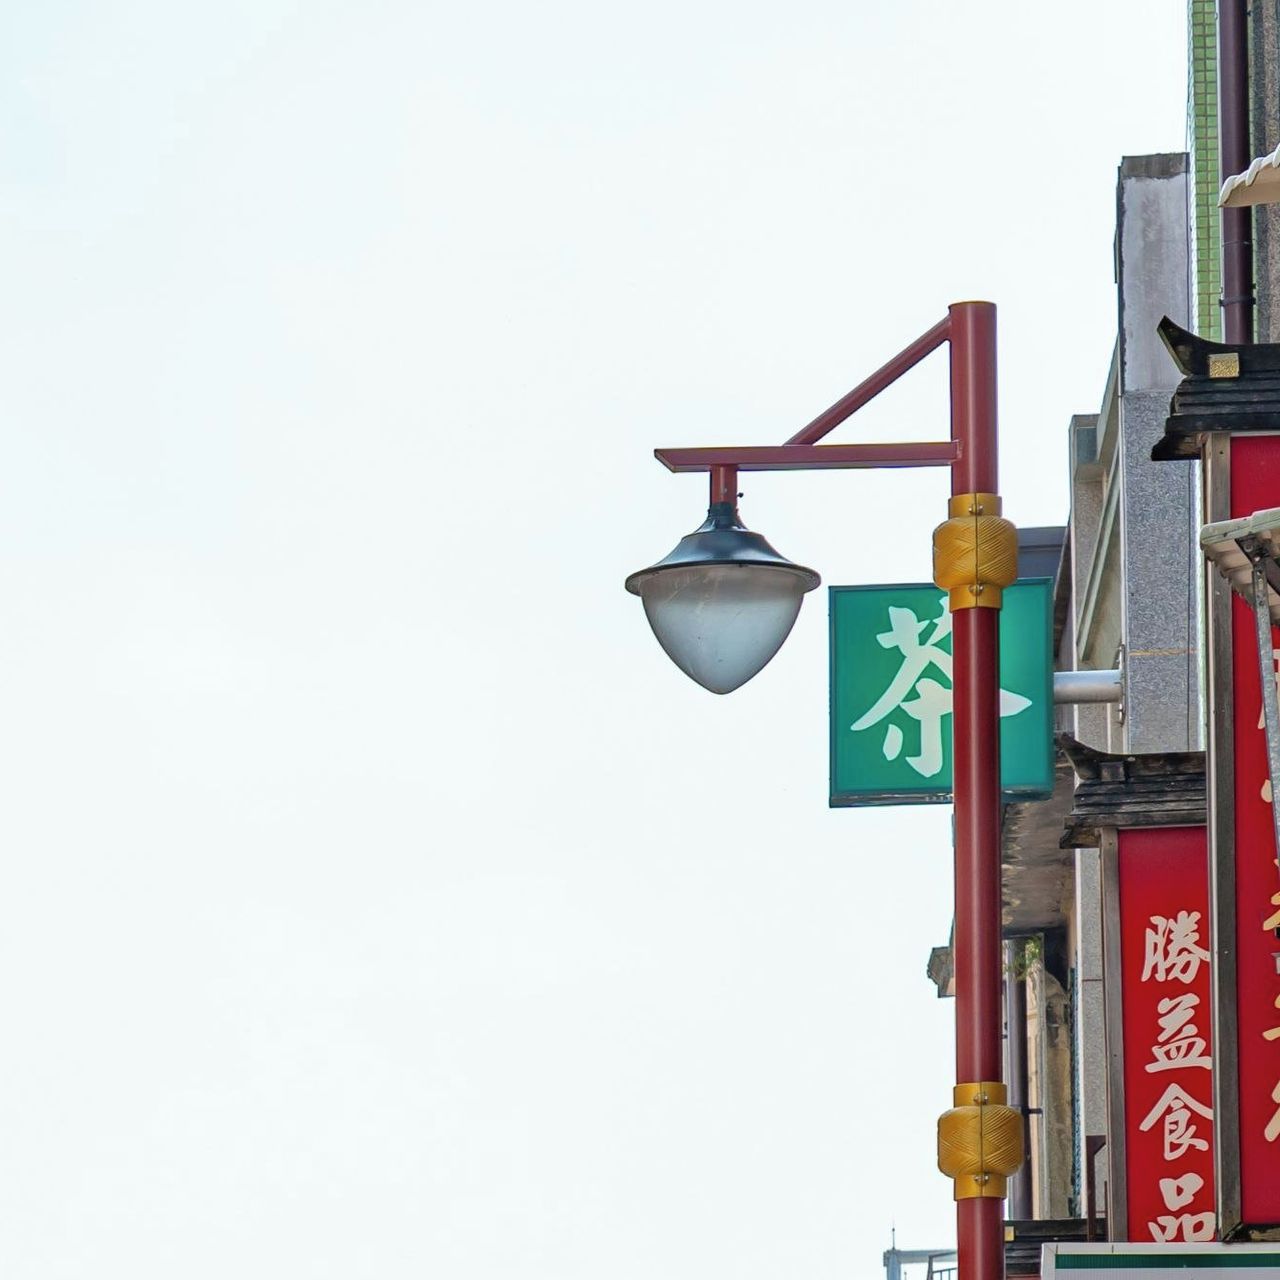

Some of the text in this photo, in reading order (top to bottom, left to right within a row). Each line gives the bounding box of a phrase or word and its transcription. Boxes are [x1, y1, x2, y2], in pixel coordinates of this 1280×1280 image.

[850, 596, 1032, 778] 茶
[1138, 911, 1217, 1242] 勝益食品
